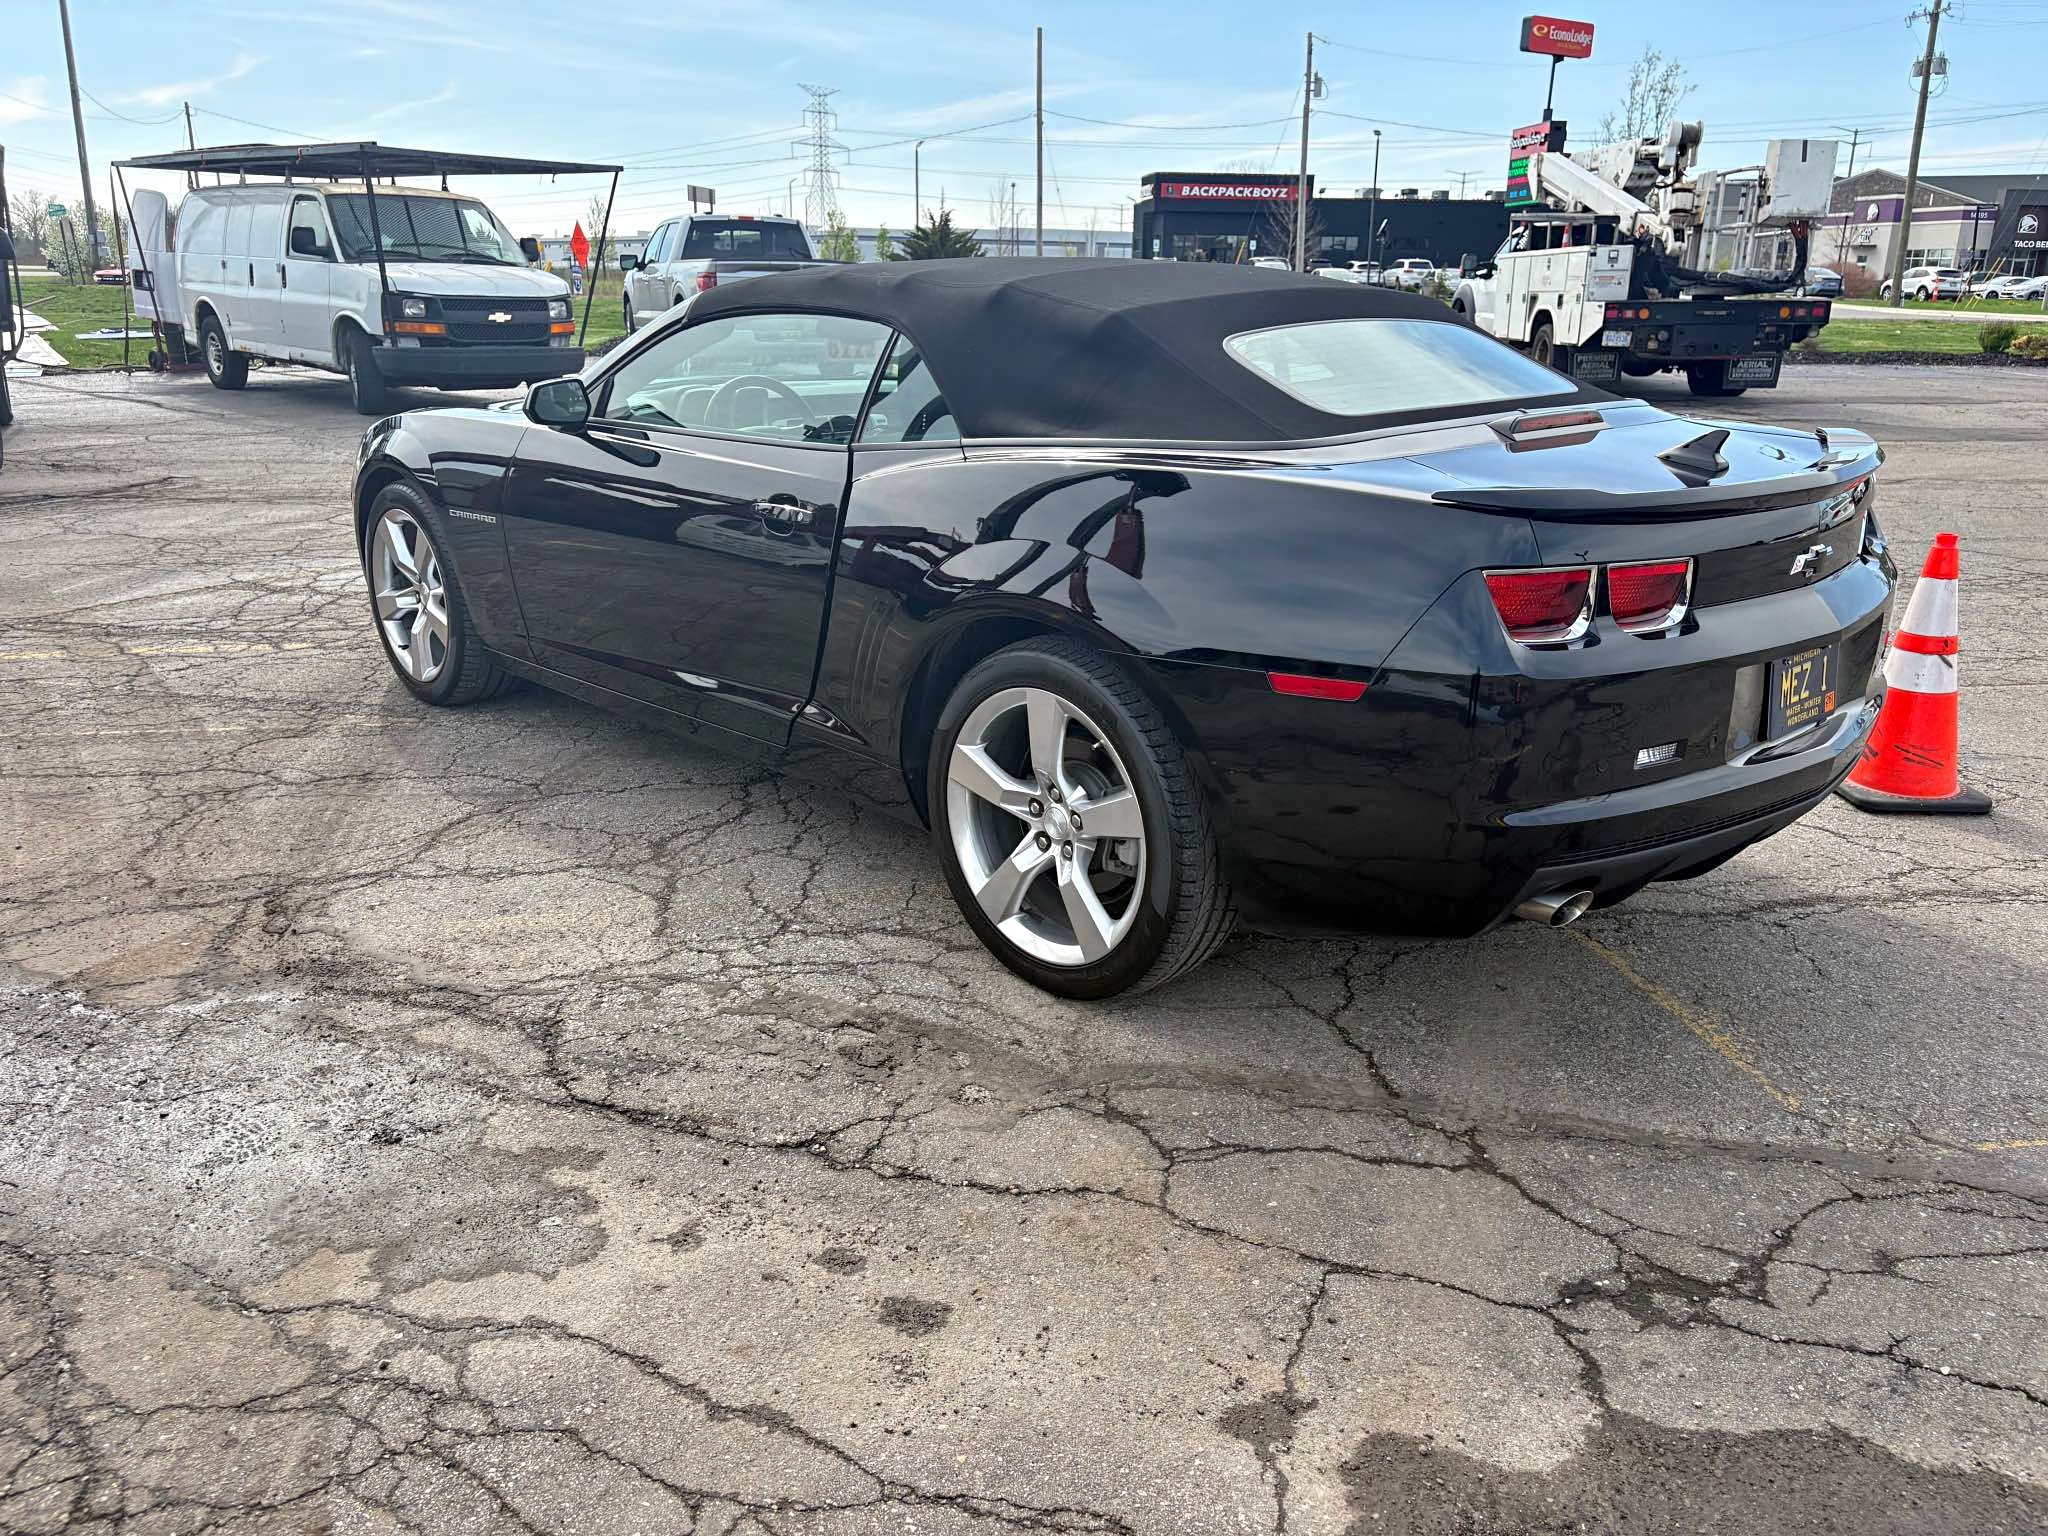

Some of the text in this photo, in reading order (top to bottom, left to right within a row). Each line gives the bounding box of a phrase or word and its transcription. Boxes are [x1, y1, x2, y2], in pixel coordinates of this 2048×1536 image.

[1181, 185, 1288, 198] BACKPACKBOYZ
[2014, 240, 2035, 248] TACO
[1737, 360, 1769, 368] AERIAL
[449, 509, 496, 523] CAMARO
[1793, 648, 1821, 664] MICHIGAN
[1780, 661, 1812, 708] MEZ
[1787, 707, 1819, 727] WONDERLAND
